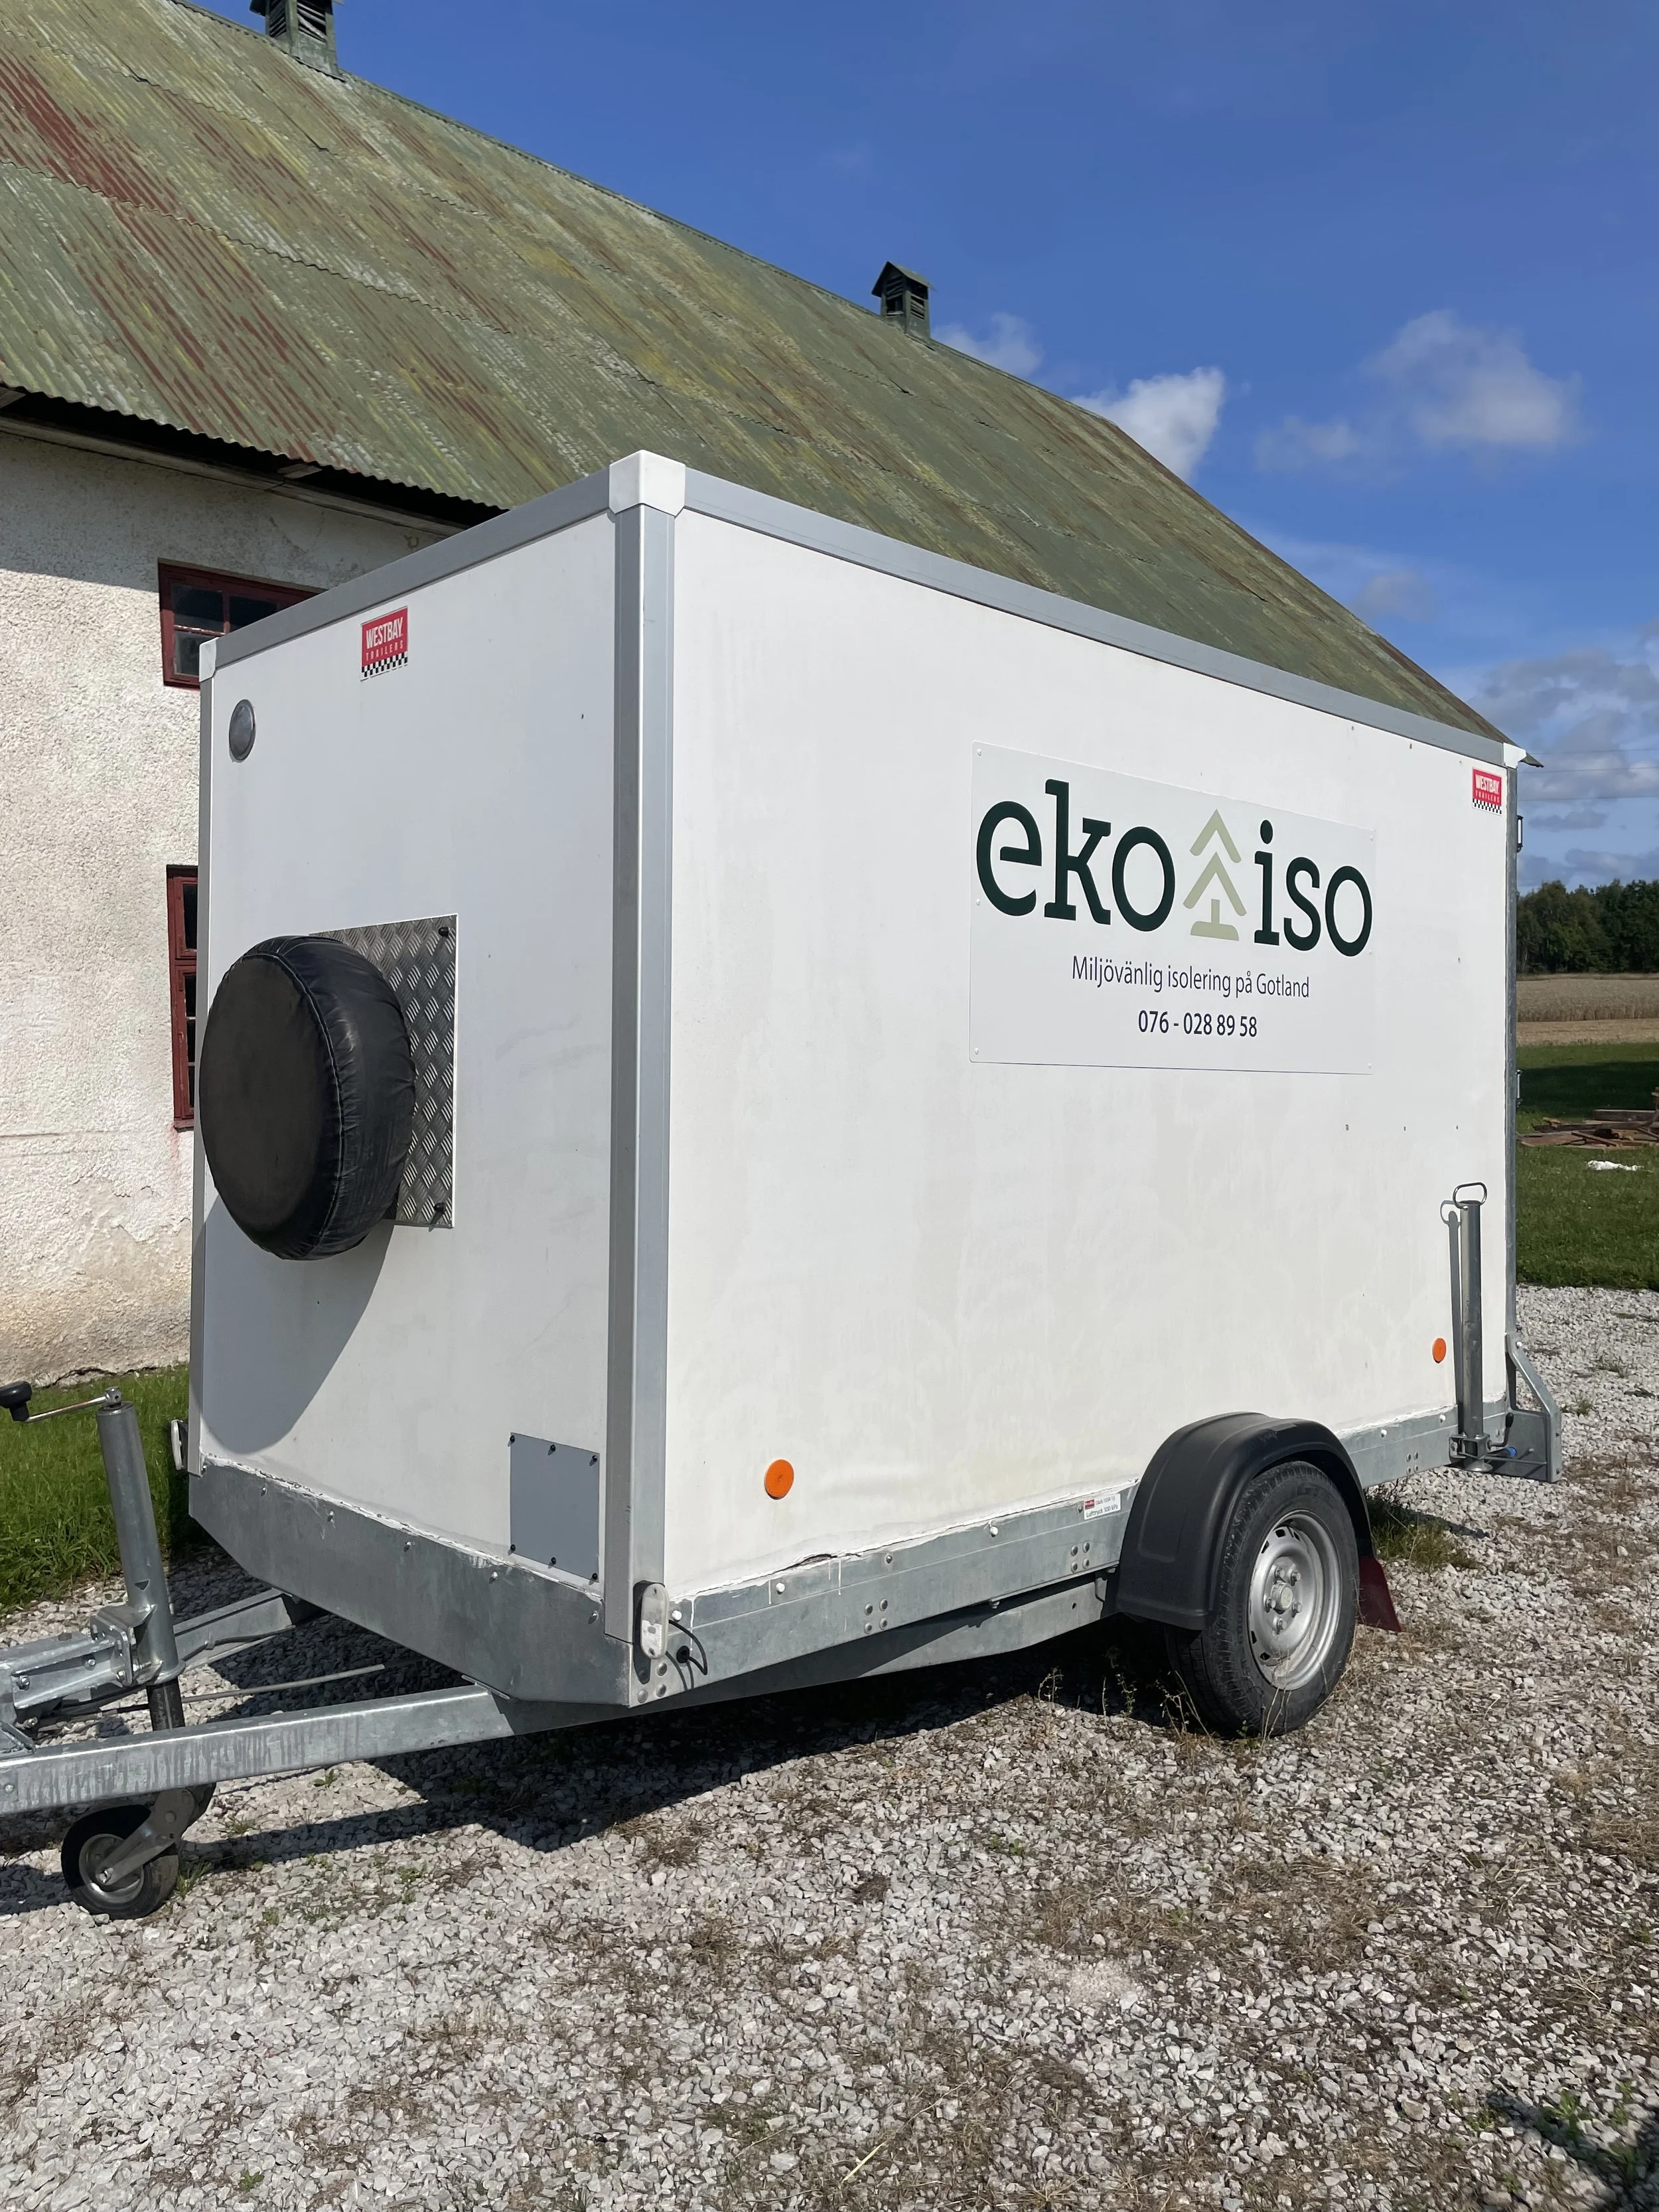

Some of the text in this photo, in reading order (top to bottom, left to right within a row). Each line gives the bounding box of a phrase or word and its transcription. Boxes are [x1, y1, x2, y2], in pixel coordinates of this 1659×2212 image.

[366, 617, 404, 649] WESTBAY
[366, 640, 403, 661] TRAILERS
[1475, 774, 1500, 794] WESTBAY
[1475, 790, 1500, 803] TRAILERS
[976, 778, 1373, 957] eko iso
[1072, 956, 1309, 998] Miljövänlig isolering på Gotland
[1138, 1009, 1169, 1033] 076
[1183, 1012, 1212, 1035] 028
[1216, 1014, 1235, 1036] 89
[1240, 1015, 1258, 1037] 58
